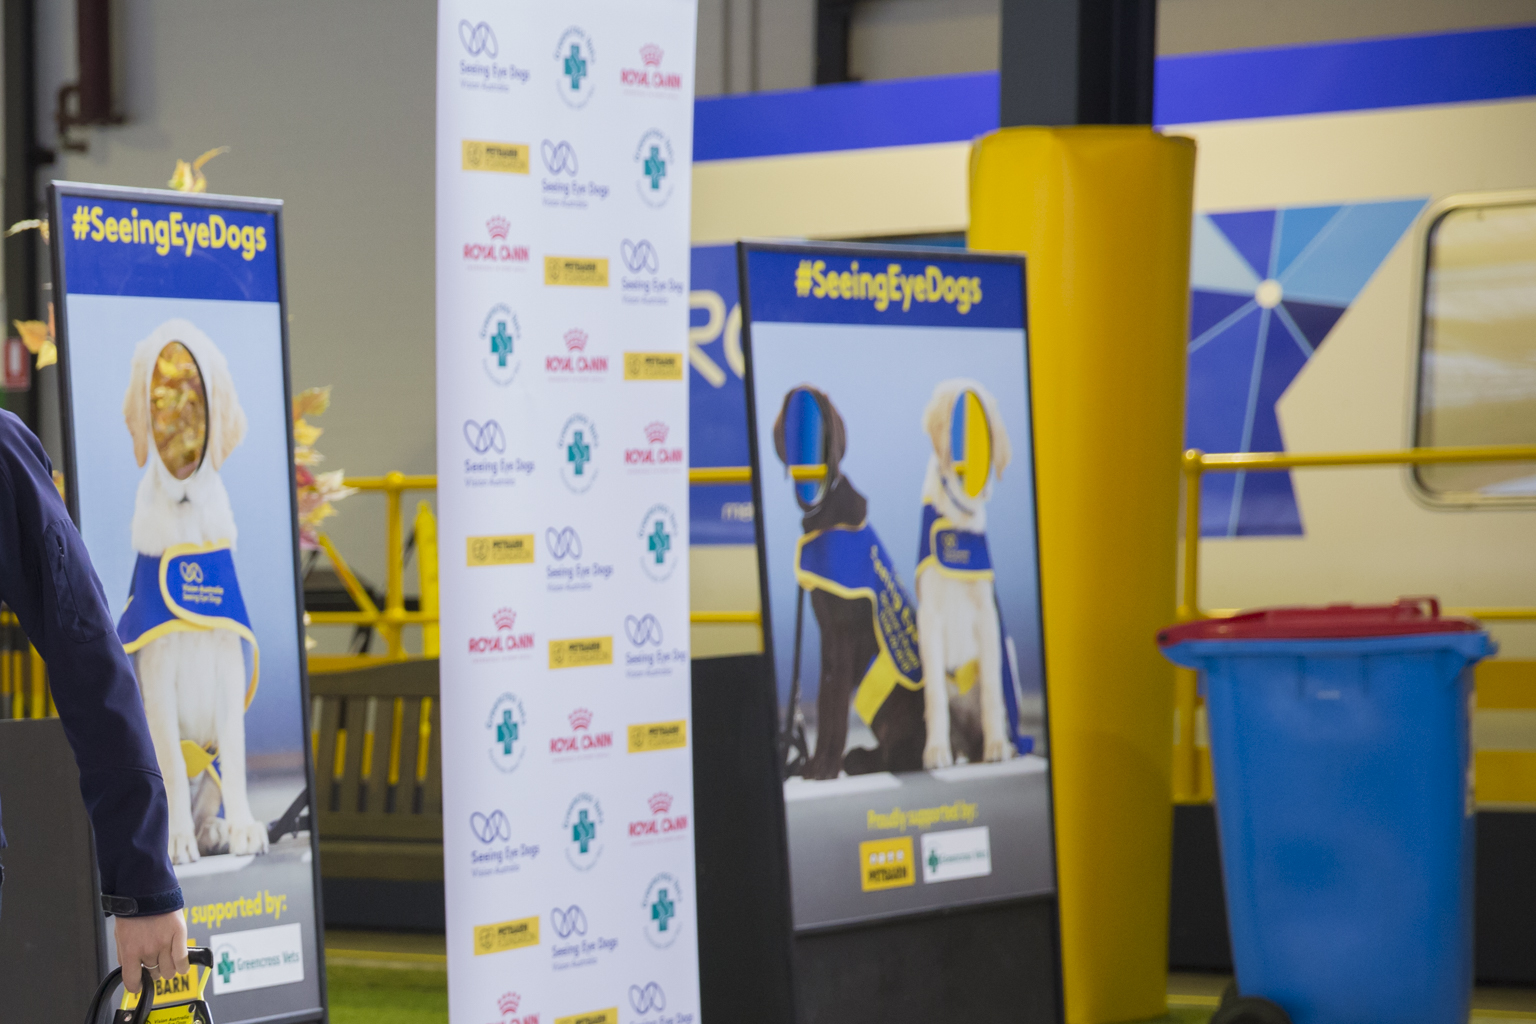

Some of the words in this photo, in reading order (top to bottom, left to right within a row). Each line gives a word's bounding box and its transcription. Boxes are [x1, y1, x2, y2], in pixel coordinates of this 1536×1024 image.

[72, 205, 267, 261] #SeeingEyeDogs
[794, 260, 982, 314] #SeeingEyeDogs
[191, 890, 262, 929] supported
[265, 890, 287, 919] by:
[237, 954, 281, 971] Greencross
